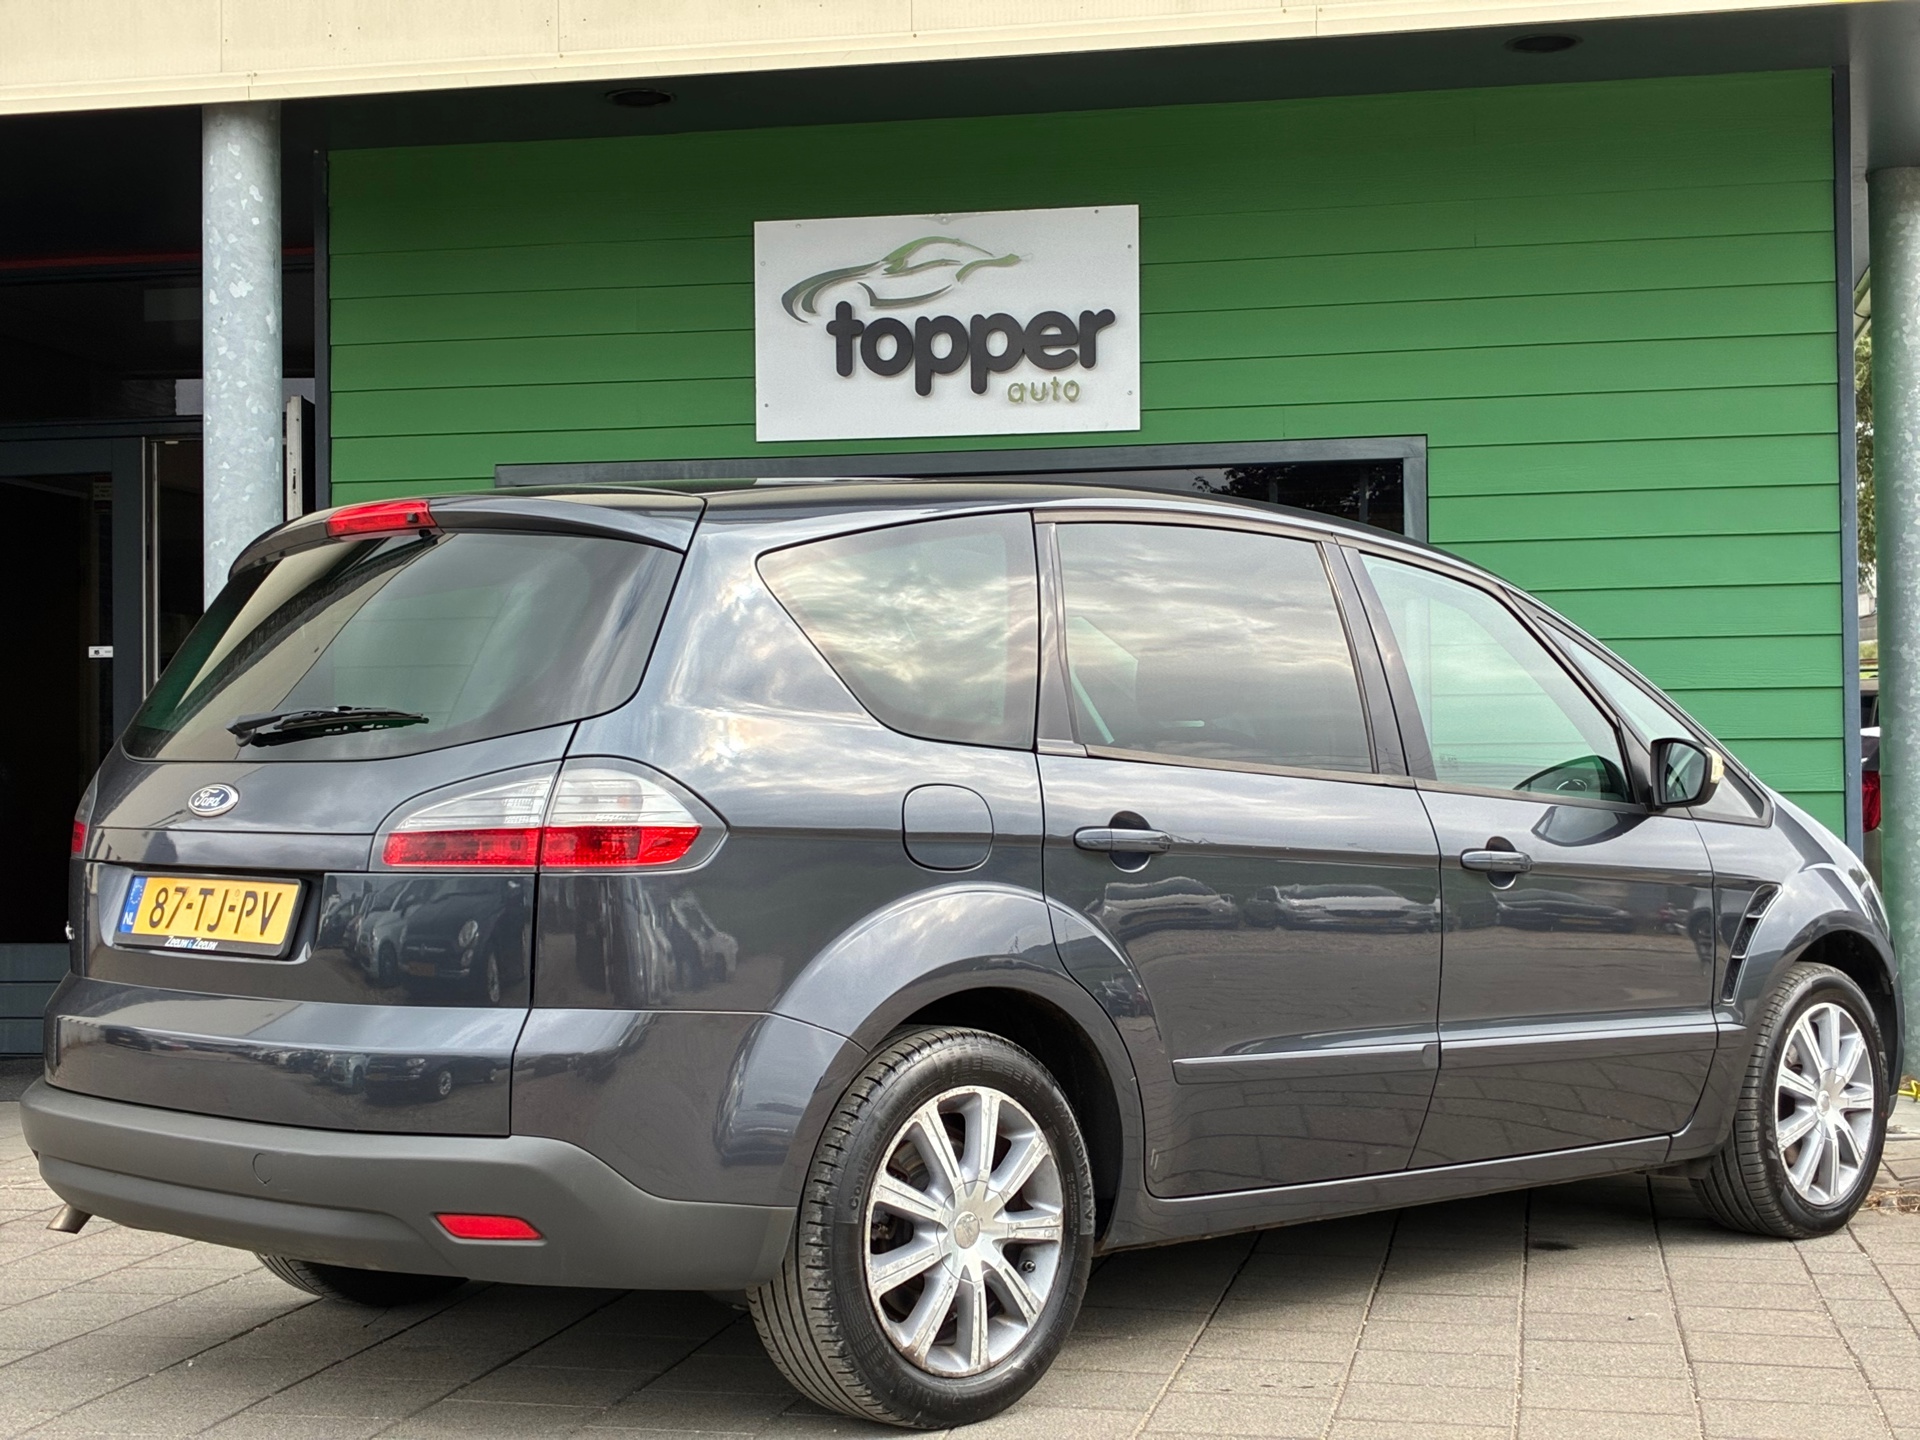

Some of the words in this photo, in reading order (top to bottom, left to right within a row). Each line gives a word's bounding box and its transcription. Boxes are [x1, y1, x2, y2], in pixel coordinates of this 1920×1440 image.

[826, 300, 1116, 396] topper
[1007, 376, 1080, 403] auto
[194, 788, 225, 807] Ford
[122, 911, 134, 925] NL
[149, 887, 283, 936] 87-TJ-PV
